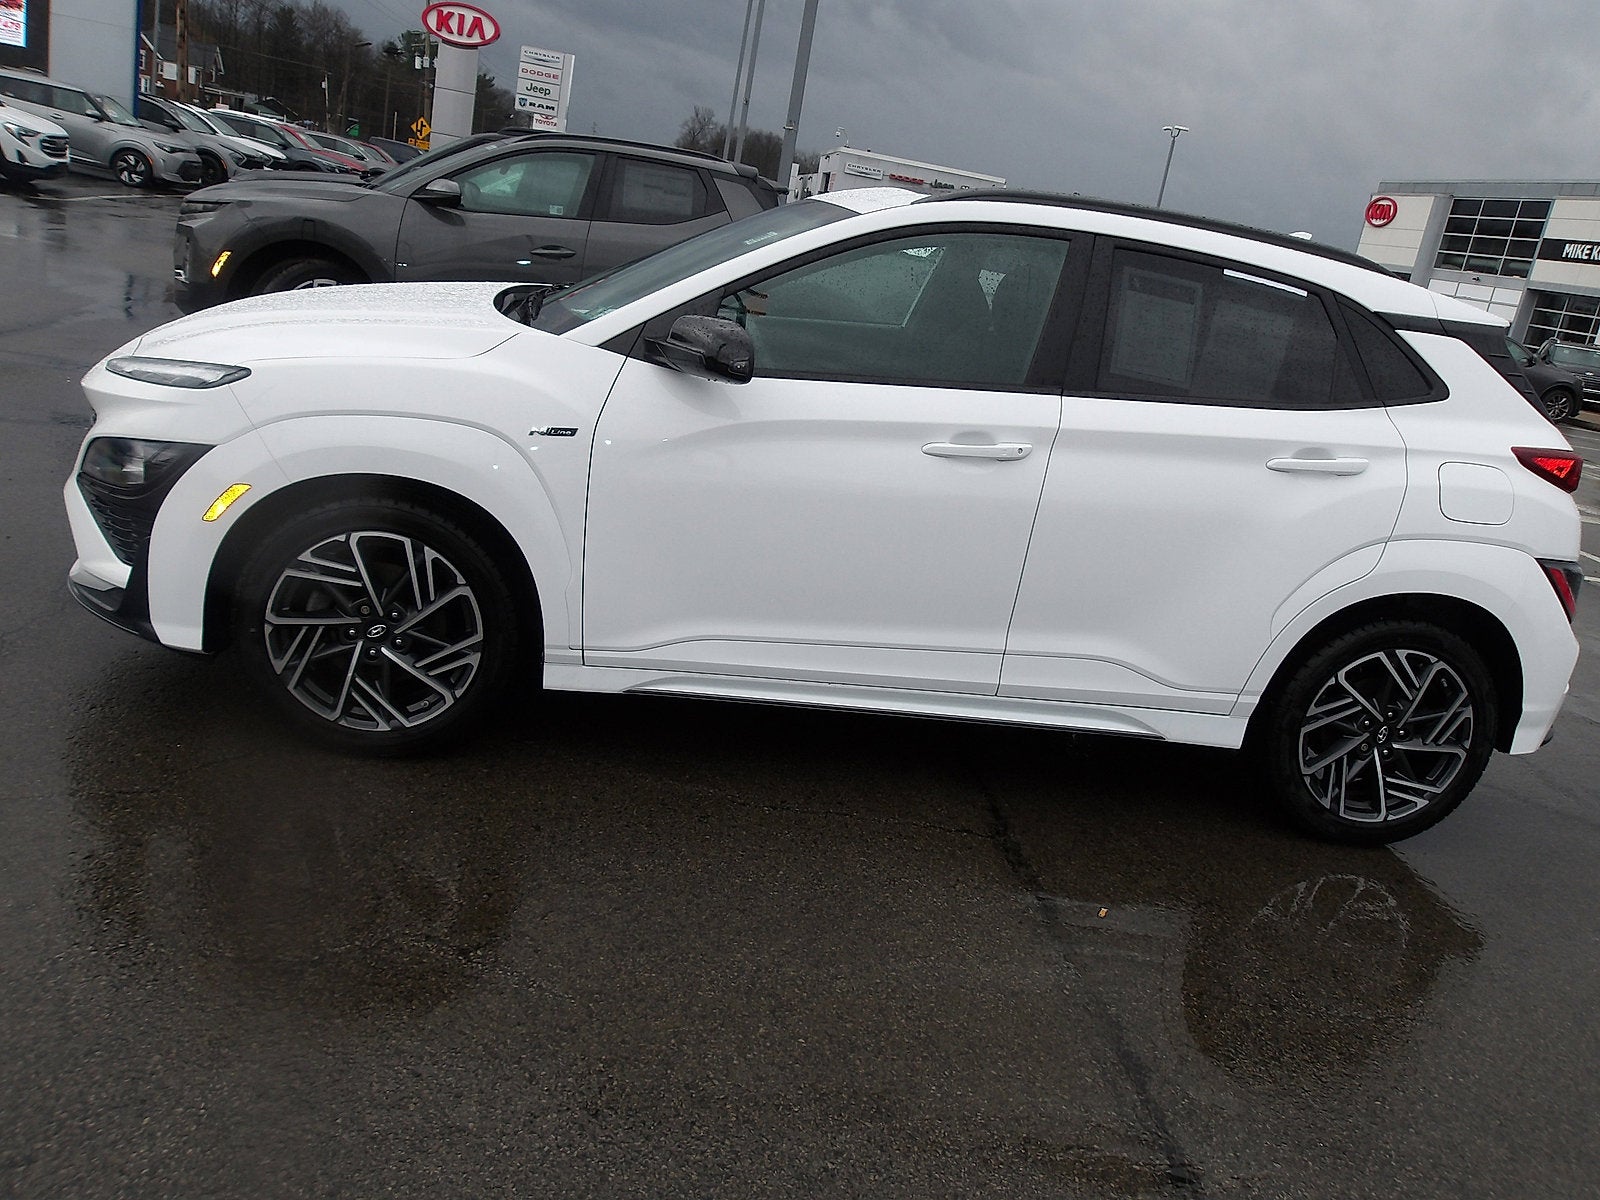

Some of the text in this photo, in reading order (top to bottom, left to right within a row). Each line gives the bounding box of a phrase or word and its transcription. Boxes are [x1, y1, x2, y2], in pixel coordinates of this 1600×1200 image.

[436, 8, 486, 40] KIA
[524, 50, 560, 60] CHRYSLER
[521, 68, 559, 80] DODGE
[526, 83, 551, 96] Jeep
[528, 101, 555, 111] RAM
[535, 118, 557, 127] TOYOTA
[848, 163, 881, 173] CHRYSLER
[1371, 203, 1392, 220] KIA
[1561, 243, 1592, 260] MIKE
